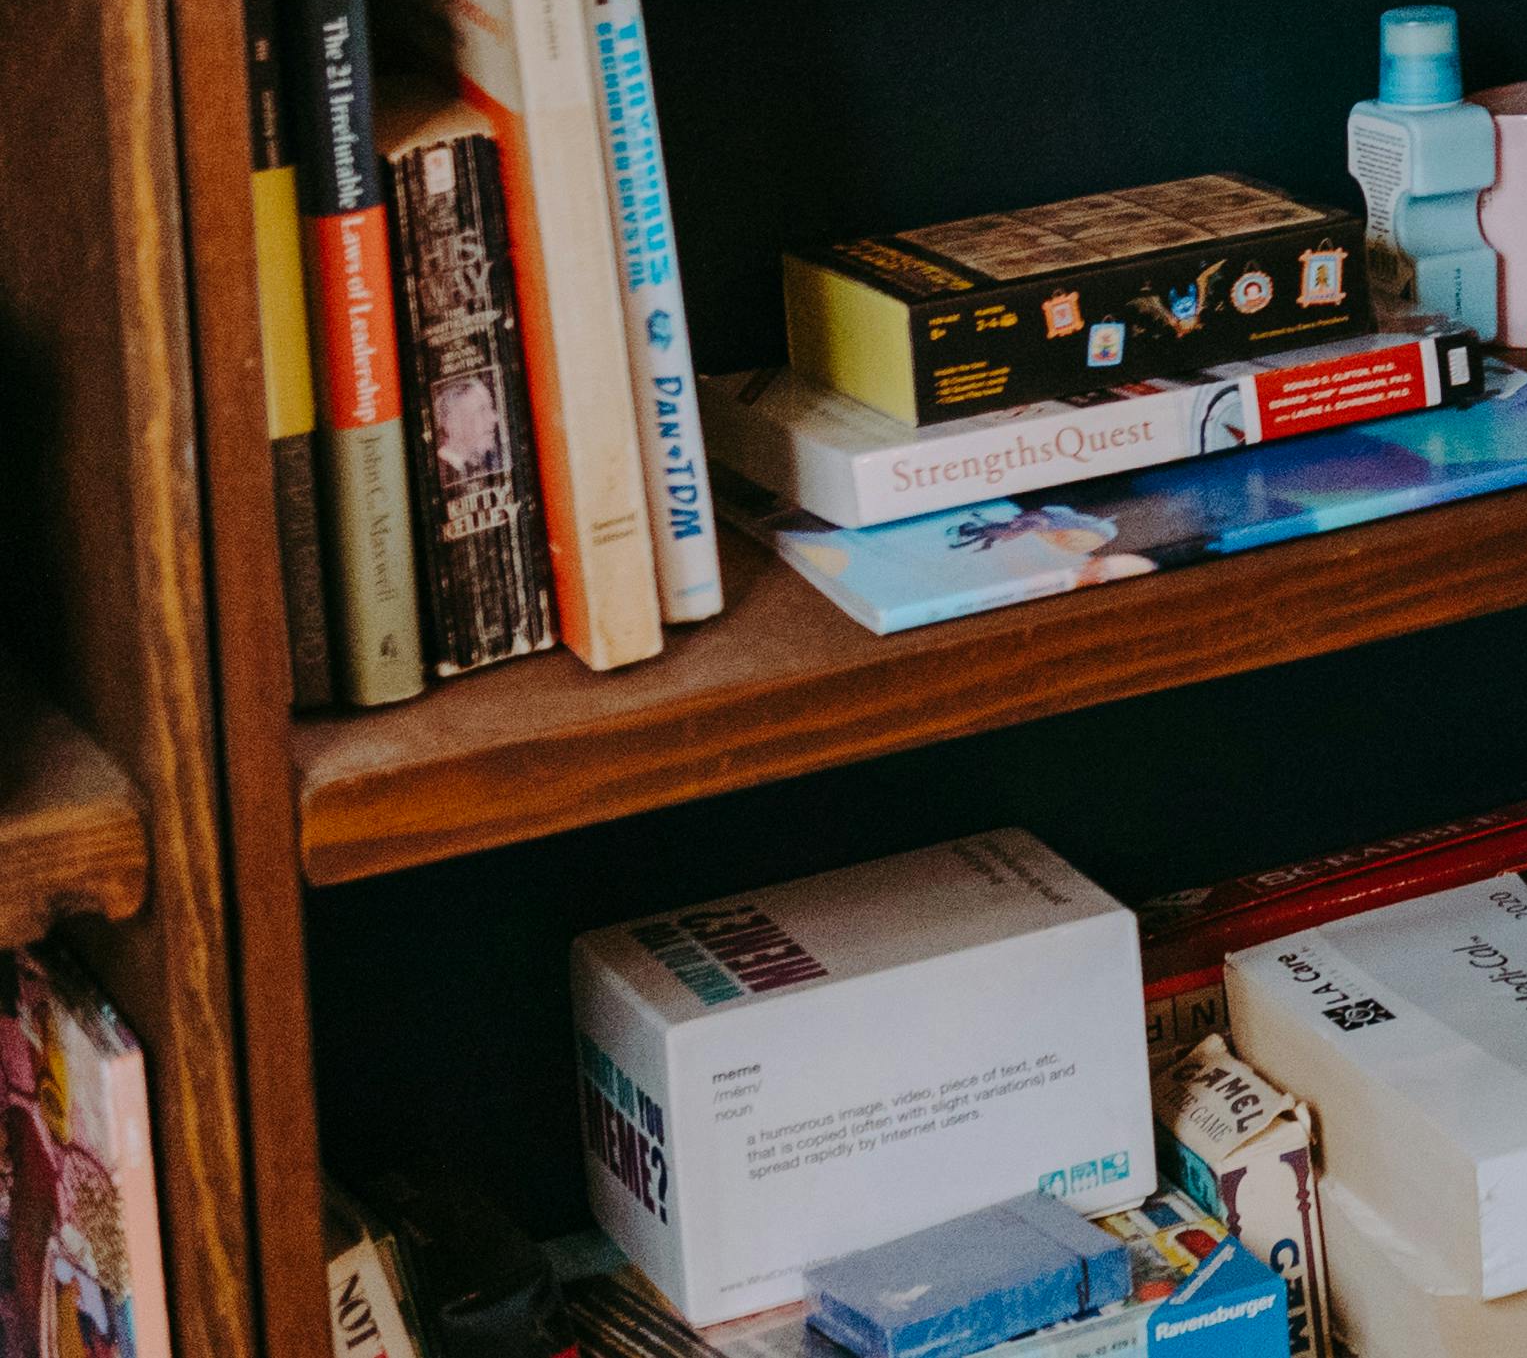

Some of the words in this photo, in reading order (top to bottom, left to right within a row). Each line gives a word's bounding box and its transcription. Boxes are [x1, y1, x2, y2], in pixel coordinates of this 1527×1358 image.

[322, 17, 349, 58] The
[325, 64, 351, 91] 21
[596, 19, 634, 171] ENCHANTED
[328, 93, 359, 209] Irrefutable
[339, 217, 366, 274] Laws
[613, 173, 643, 292] CRYSTAL
[346, 275, 369, 299] of
[347, 303, 377, 422] Leadership
[358, 433, 383, 486] John
[890, 419, 1156, 495] StrengthsQuest
[366, 516, 398, 603] Maxwell
[1278, 952, 1322, 984] Care
[711, 1062, 762, 1086] meme
[745, 1134, 757, 1146] a
[758, 1113, 835, 1144] humorous
[890, 1086, 935, 1109] video,
[939, 1075, 980, 1100] piece
[981, 1067, 998, 1084] of
[999, 1059, 1032, 1081] text,
[1172, 1061, 1265, 1134] CAMEL
[635, 1084, 666, 1149] YOU
[714, 1103, 754, 1124] noun
[746, 1145, 777, 1165] that
[780, 1142, 795, 1156] is
[796, 1125, 848, 1156] copied
[850, 1114, 895, 1141] (often
[896, 1106, 928, 1125] with
[930, 1092, 971, 1117] slight
[972, 1074, 1047, 1104] variations)
[1048, 1063, 1077, 1083] and
[747, 1154, 802, 1184] spread
[803, 1140, 857, 1169] rapidly
[858, 1136, 879, 1154] by
[879, 1119, 937, 1146] Internet
[940, 1107, 986, 1130] users.
[1190, 1105, 1233, 1143] GAME
[582, 1075, 669, 1227] MEME?
[332, 1271, 382, 1352] NOT
[1155, 1293, 1277, 1342] Ravensburger
